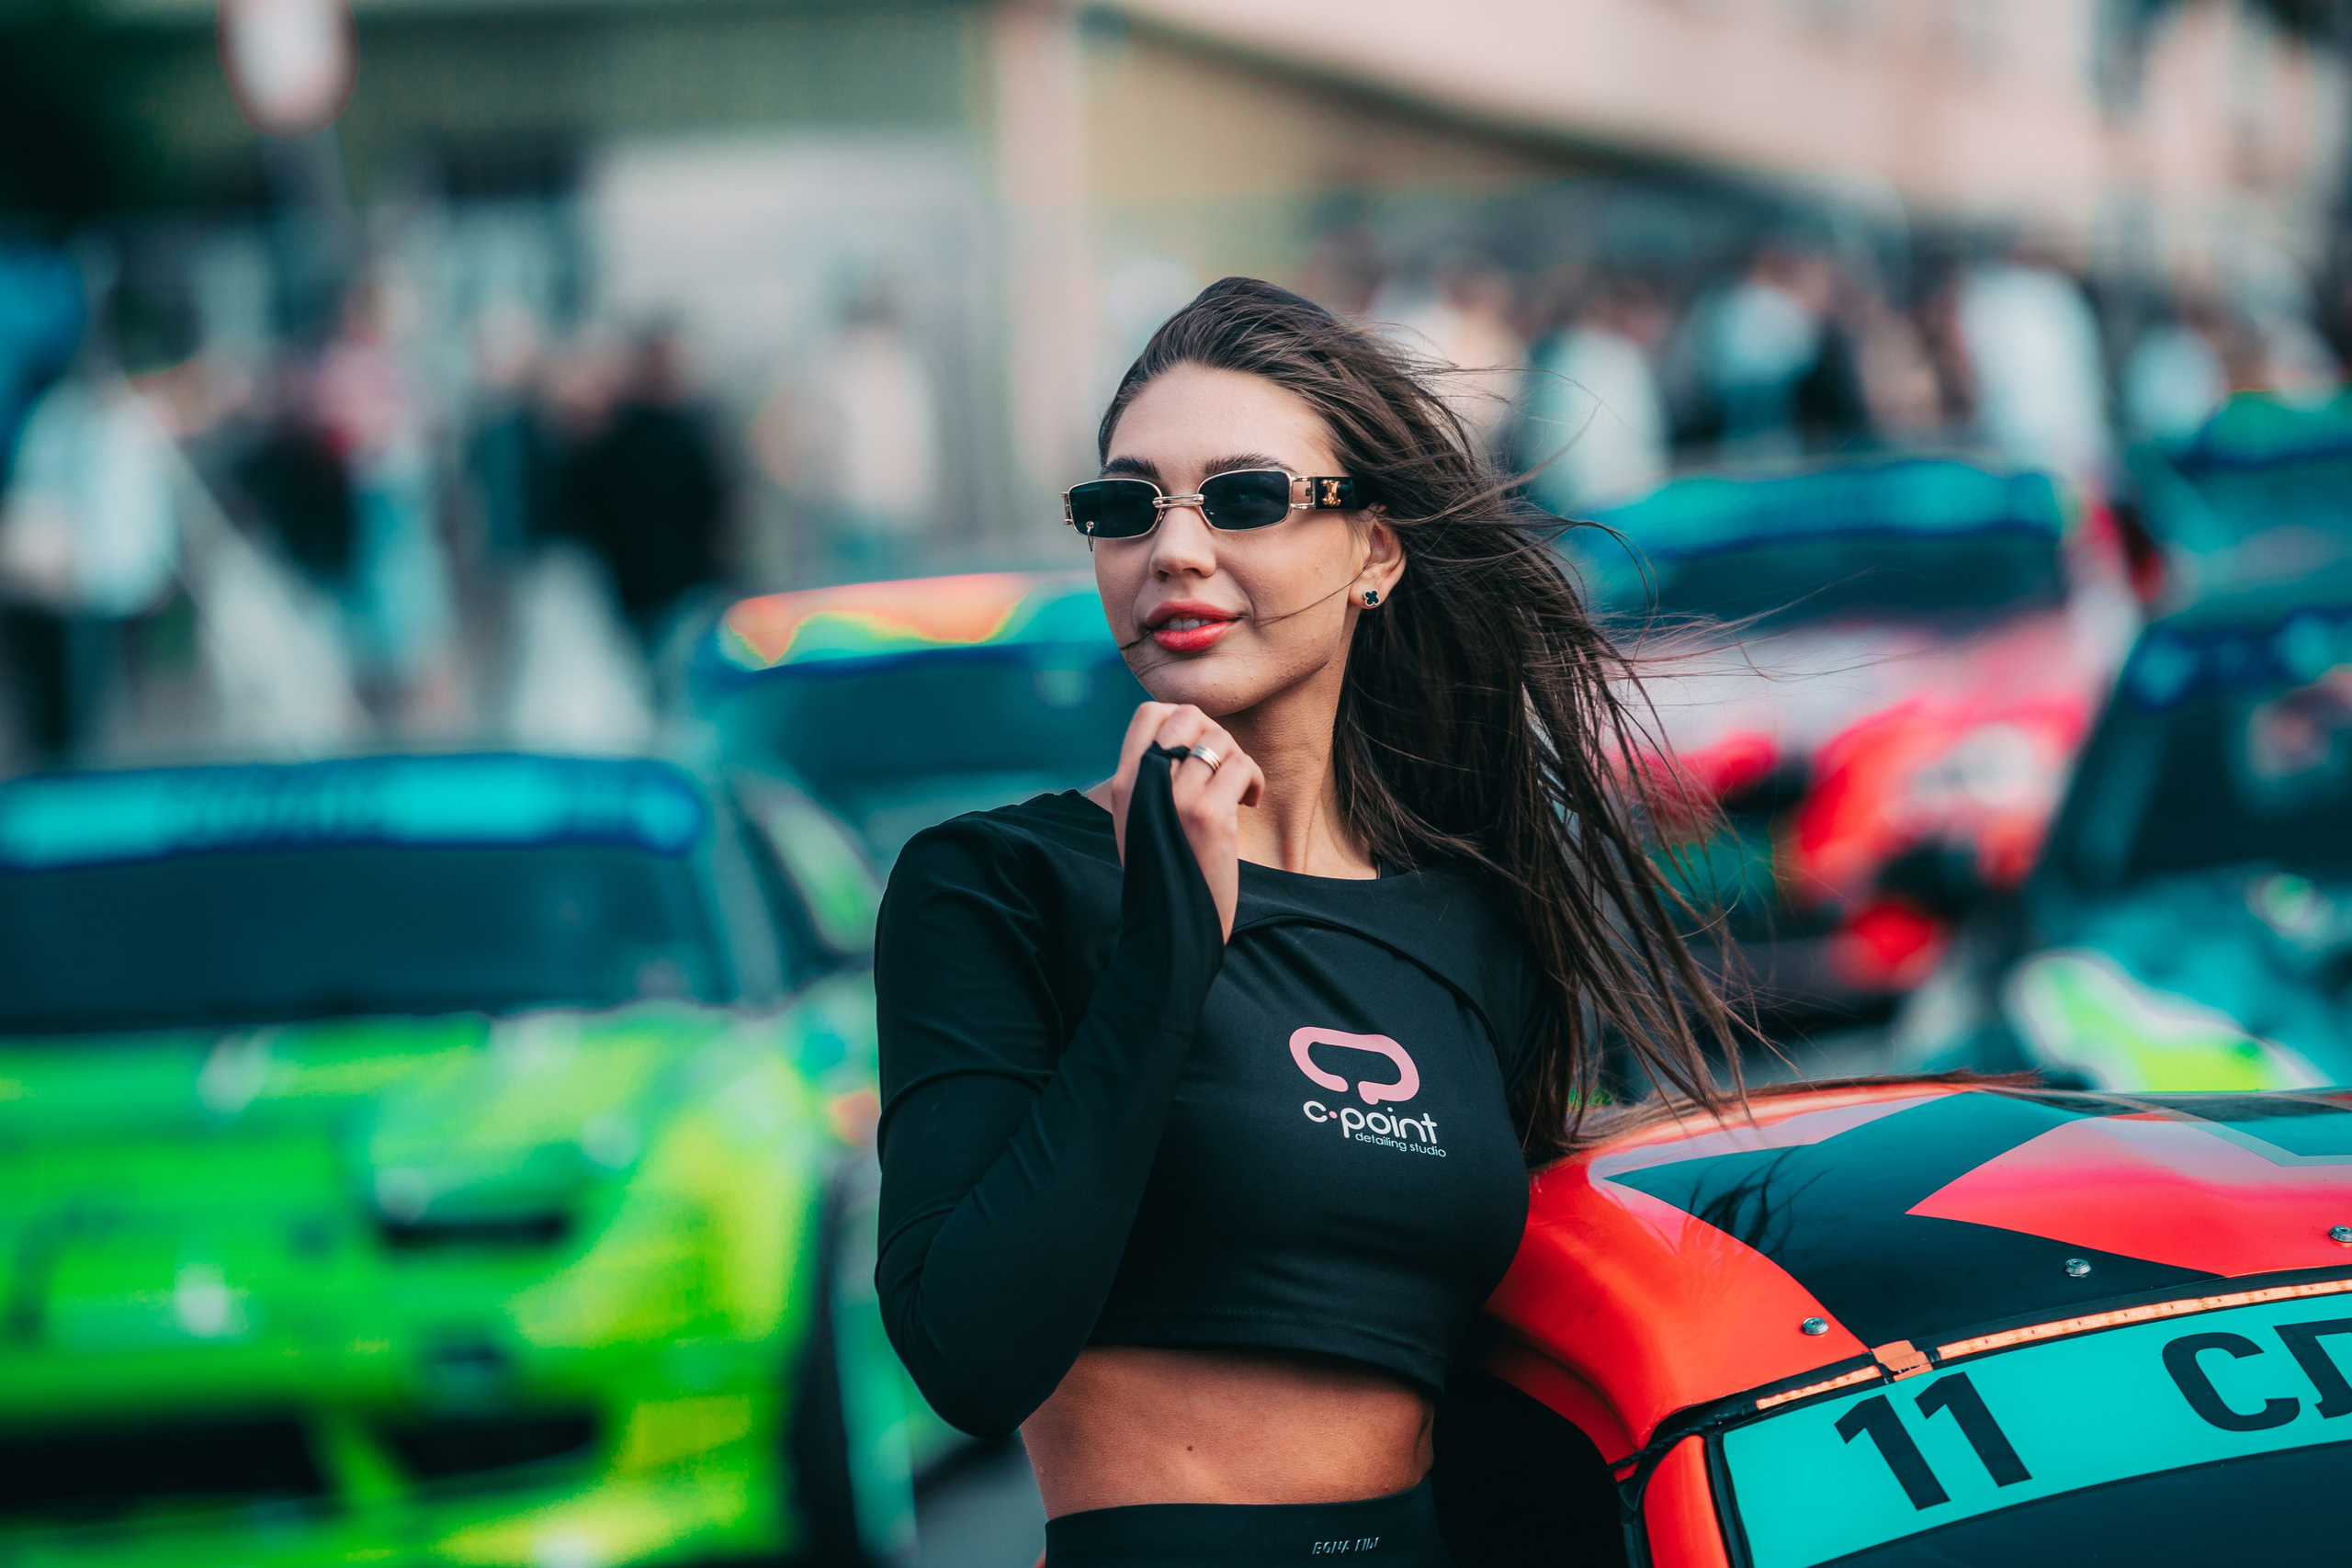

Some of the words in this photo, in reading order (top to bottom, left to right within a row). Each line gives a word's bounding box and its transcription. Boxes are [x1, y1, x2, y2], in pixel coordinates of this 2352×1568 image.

[1354, 1133, 1408, 1152] detailing
[1409, 1143, 1447, 1157] studio
[1834, 1371, 2032, 1511] 11
